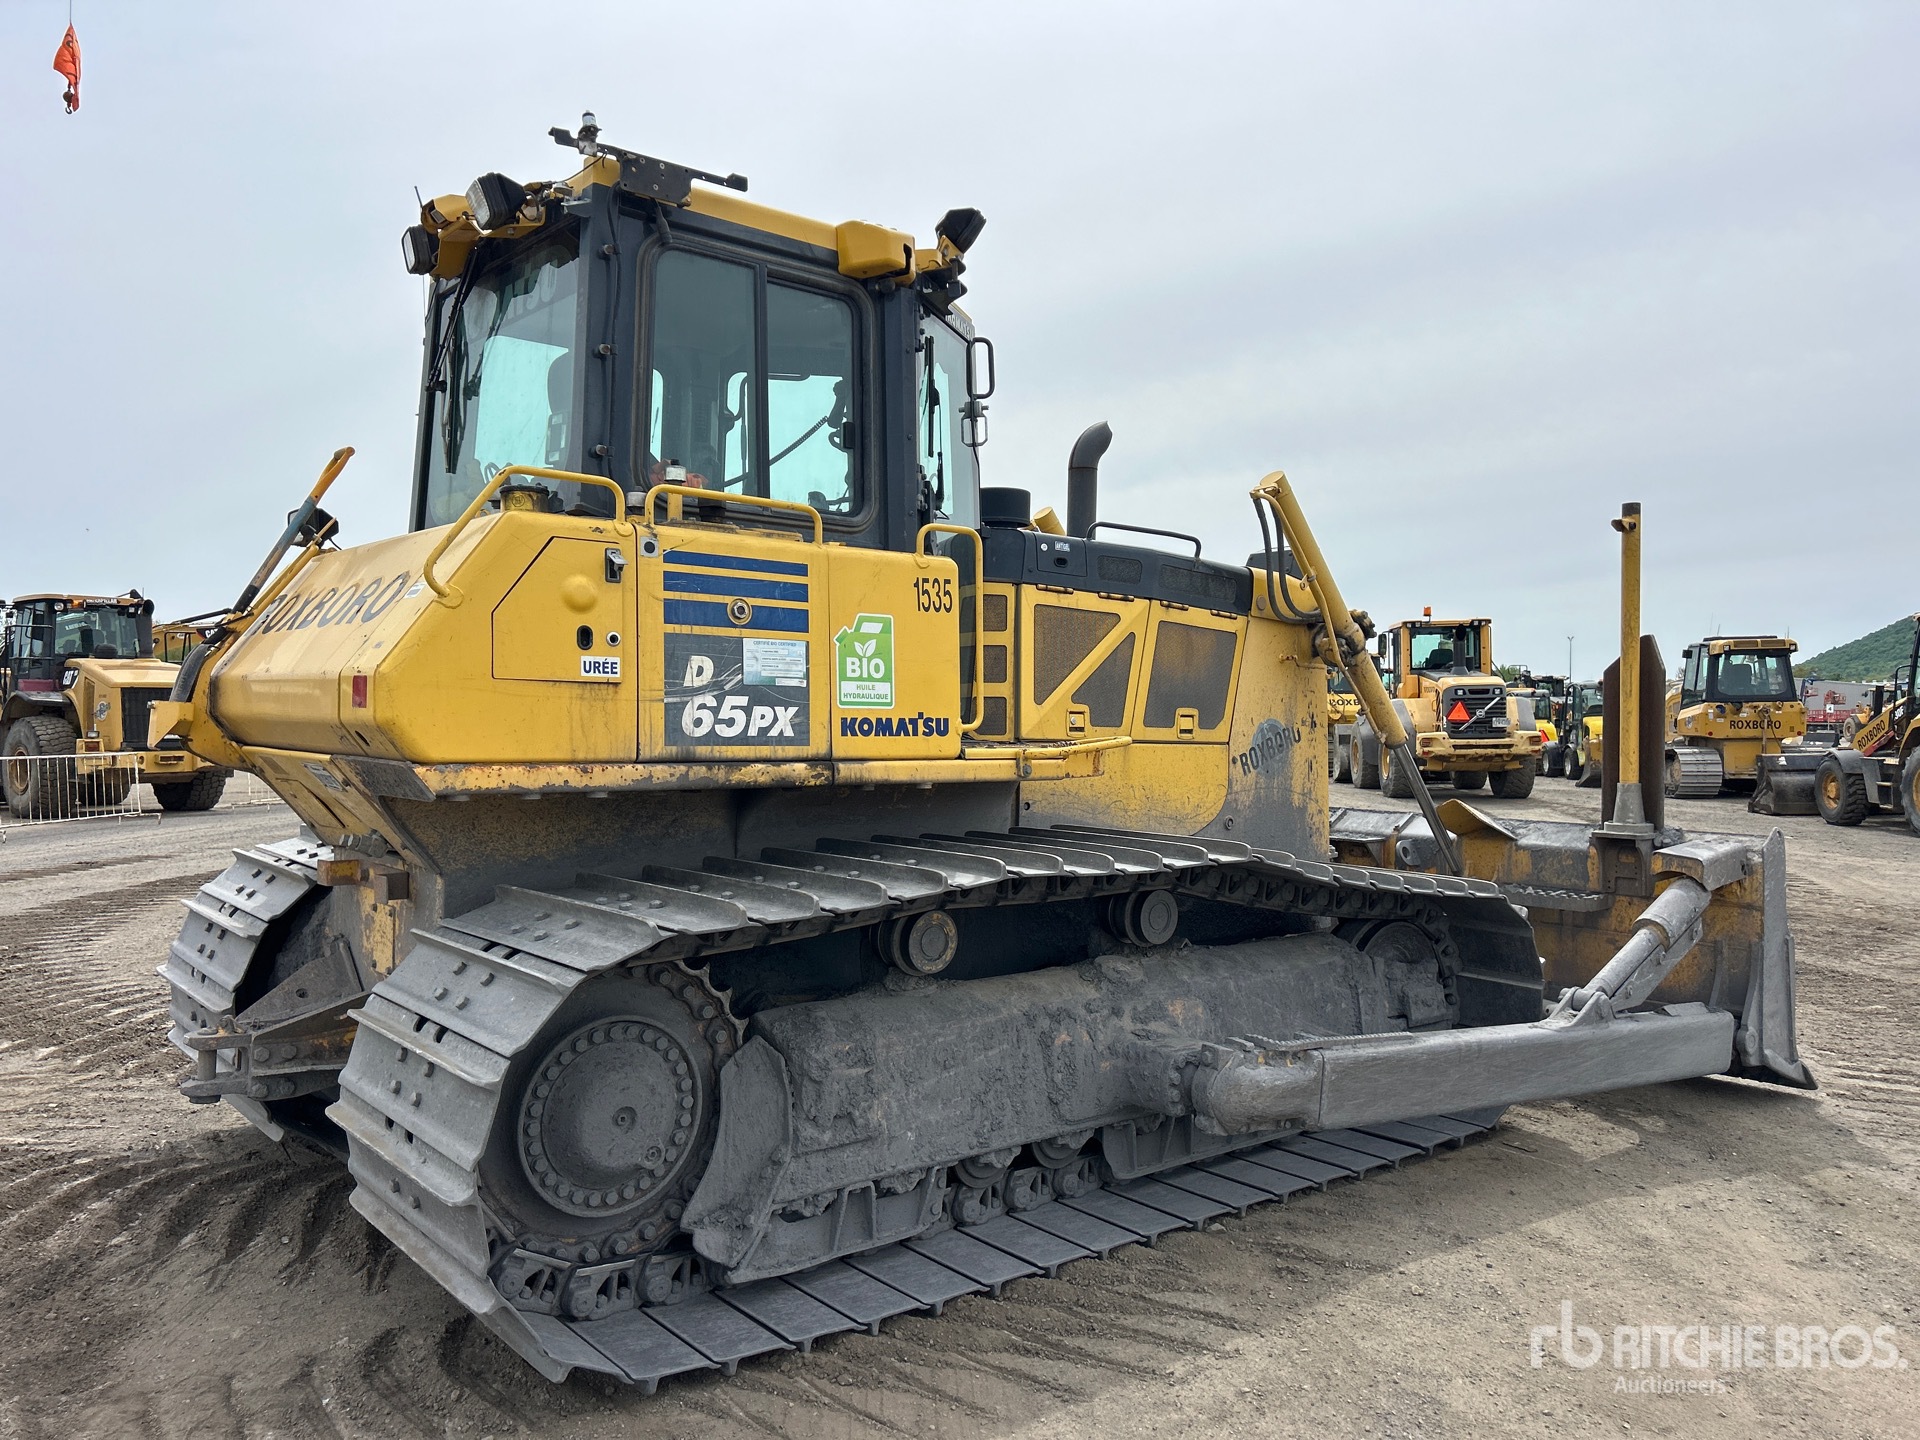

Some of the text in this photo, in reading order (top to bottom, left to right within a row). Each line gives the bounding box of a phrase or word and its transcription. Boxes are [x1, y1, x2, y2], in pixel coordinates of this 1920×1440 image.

[913, 577, 953, 613] 1535
[583, 658, 618, 675] URÉE
[683, 655, 715, 688] D
[846, 657, 885, 679] BIO
[843, 692, 889, 700] HYDRAULIQUE
[840, 711, 950, 738] KOMATSU
[1729, 719, 1782, 730] ROXBORO
[1857, 720, 1886, 750] ROXBORO
[1239, 726, 1301, 776] ROXBORO
